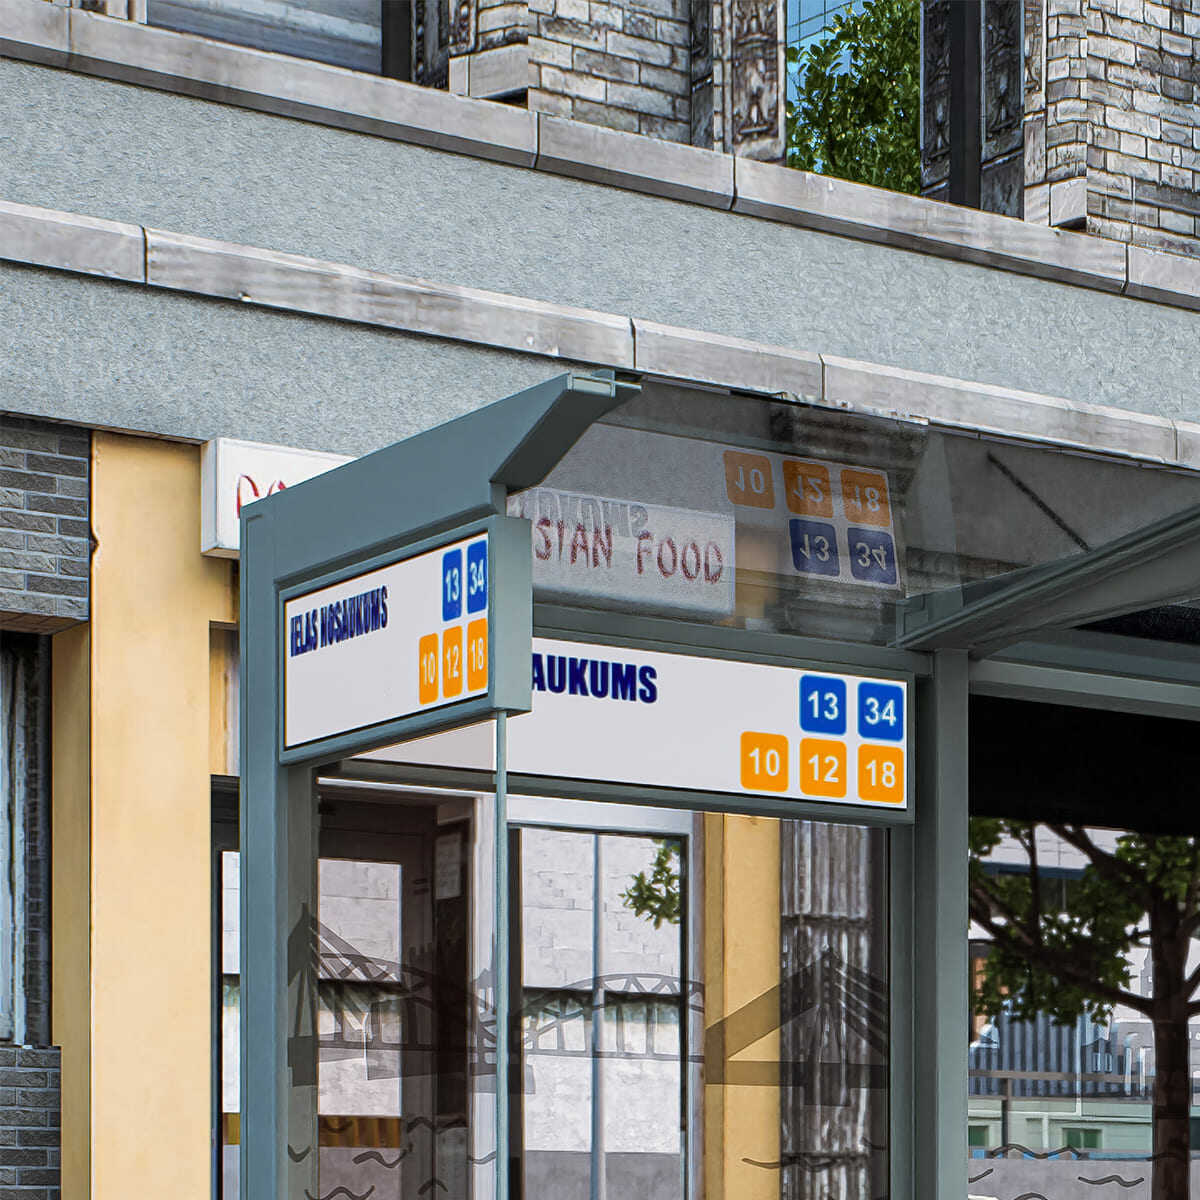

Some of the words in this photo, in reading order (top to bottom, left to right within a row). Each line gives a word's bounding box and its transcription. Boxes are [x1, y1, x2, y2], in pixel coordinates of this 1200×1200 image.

[534, 516, 613, 569] SIAN
[636, 529, 723, 584] FOOD
[445, 567, 460, 603] 13
[469, 559, 485, 596] 34
[290, 608, 318, 657] IELAS
[320, 585, 388, 648] NOSAUKUMS
[422, 652, 436, 686] 10
[446, 645, 459, 679] 12
[470, 638, 485, 672] 18
[531, 652, 658, 704] AUKUMS
[807, 690, 839, 720] 13
[864, 697, 897, 727] 34
[748, 748, 780, 776] 10
[807, 754, 839, 783] 12
[865, 760, 896, 789] 18
